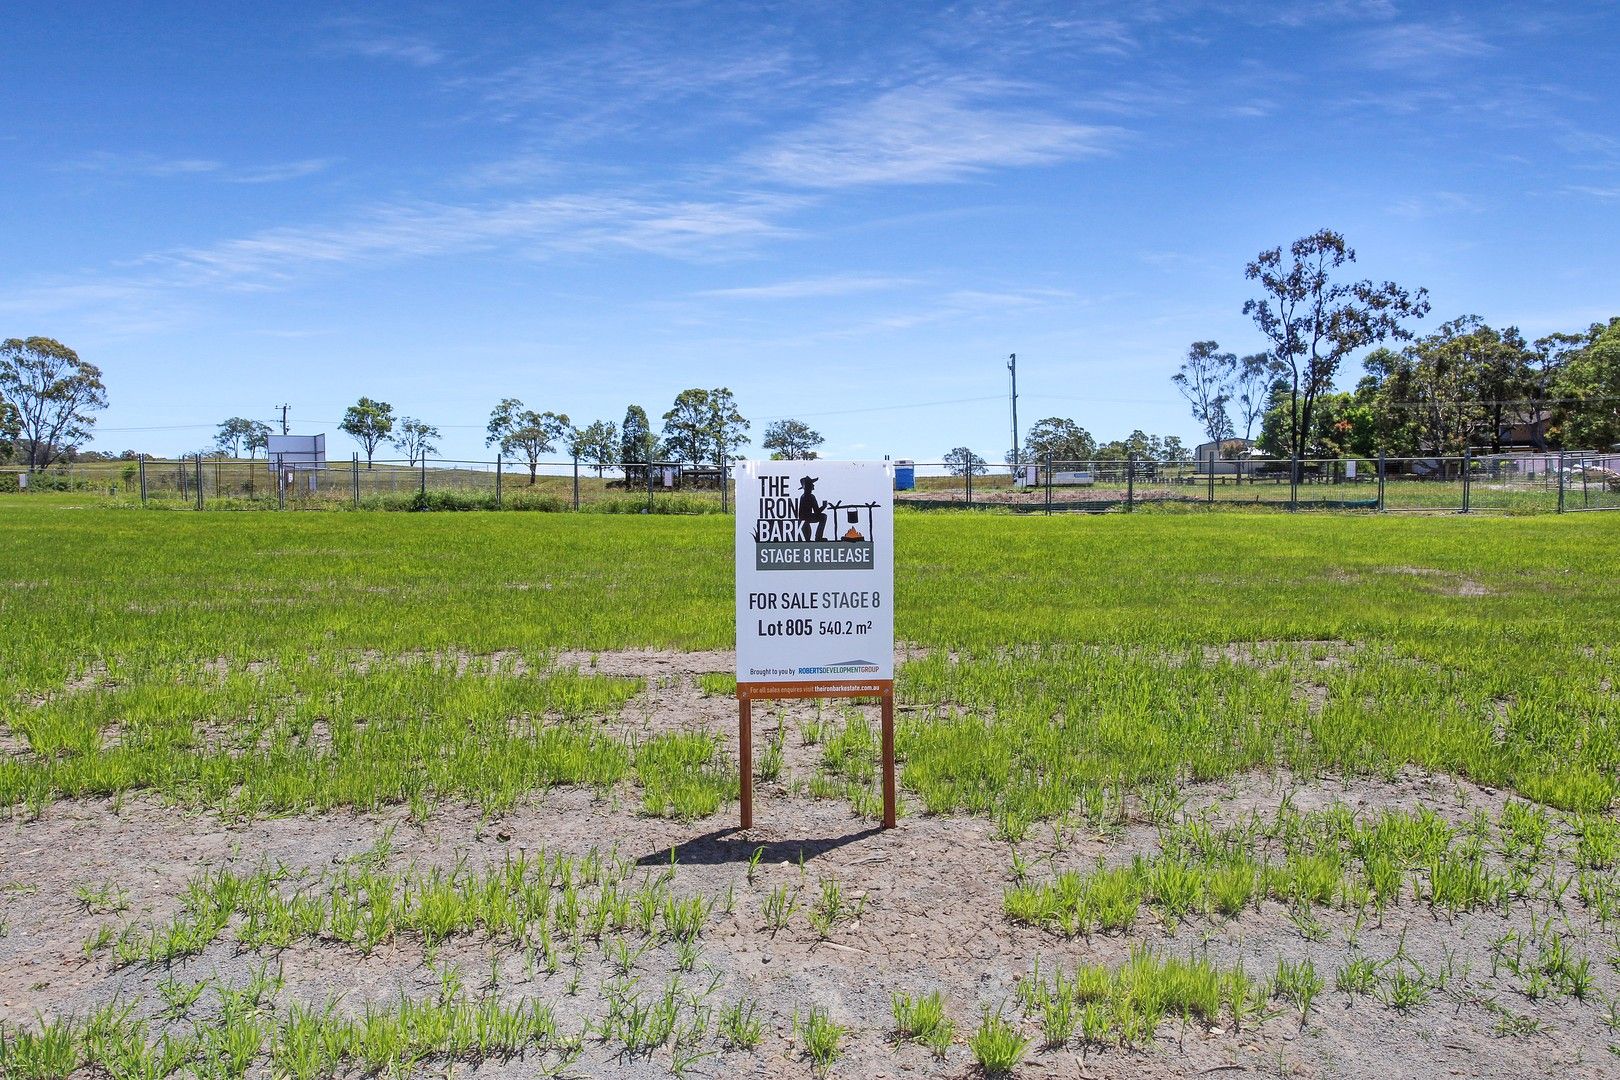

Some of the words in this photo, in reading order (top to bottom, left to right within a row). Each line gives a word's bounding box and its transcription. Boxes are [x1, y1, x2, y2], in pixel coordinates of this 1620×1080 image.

[758, 475, 790, 497] THE
[759, 497, 799, 519] IRON
[759, 520, 806, 541] BARK
[760, 548, 800, 563] STAGE
[803, 548, 811, 563] 8
[814, 548, 870, 562] RELEASE
[749, 592, 777, 610] FOR
[781, 592, 818, 609] SALE
[822, 591, 869, 608] STAGE
[872, 591, 880, 608] 8
[758, 619, 783, 636] Lot
[785, 618, 813, 636] 805
[819, 621, 853, 635] 540.2
[750, 668, 771, 676] Brought
[789, 668, 796, 676] by
